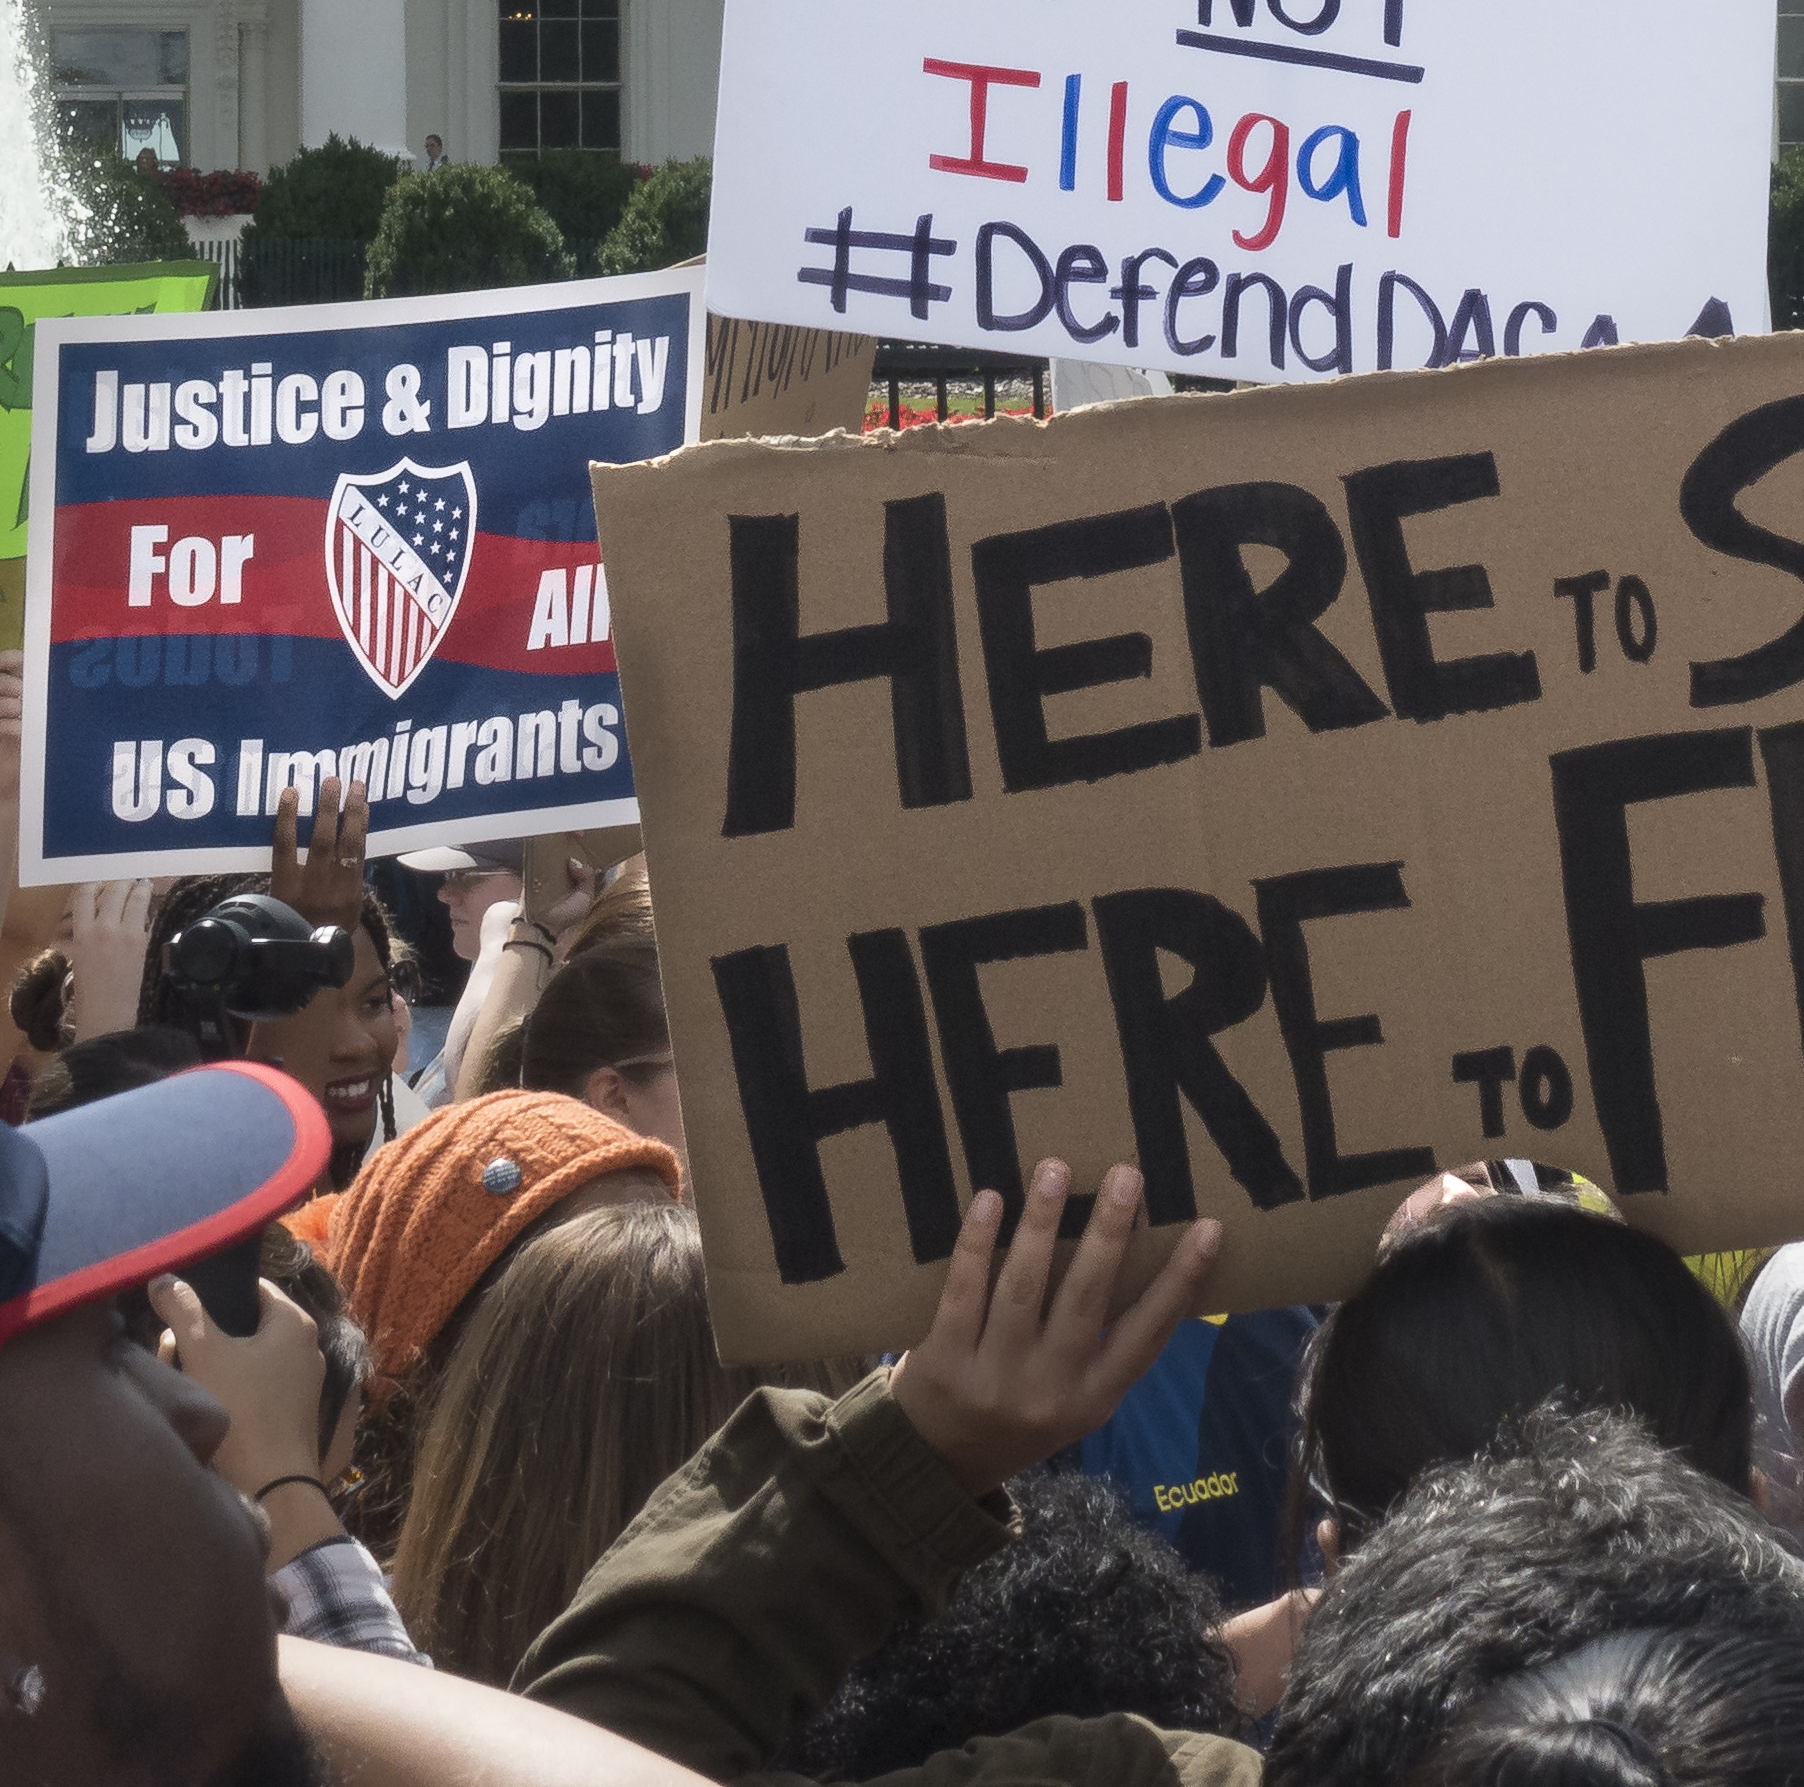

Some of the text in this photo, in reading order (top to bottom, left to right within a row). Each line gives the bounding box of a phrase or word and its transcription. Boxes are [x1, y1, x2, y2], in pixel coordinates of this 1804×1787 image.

[922, 58, 1412, 251] Illegal
[86, 362, 365, 453] Justice
[383, 362, 431, 434] &
[447, 330, 670, 430] Dignity
[128, 524, 253, 607] For
[348, 503, 446, 615] LULAC
[719, 453, 1542, 837] HERE
[1554, 569, 1657, 675] TO
[112, 699, 620, 823] US Immigrants
[710, 860, 1439, 1286] HERE
[1450, 1046, 1574, 1138] TO
[1153, 1471, 1239, 1512] Ecuador
